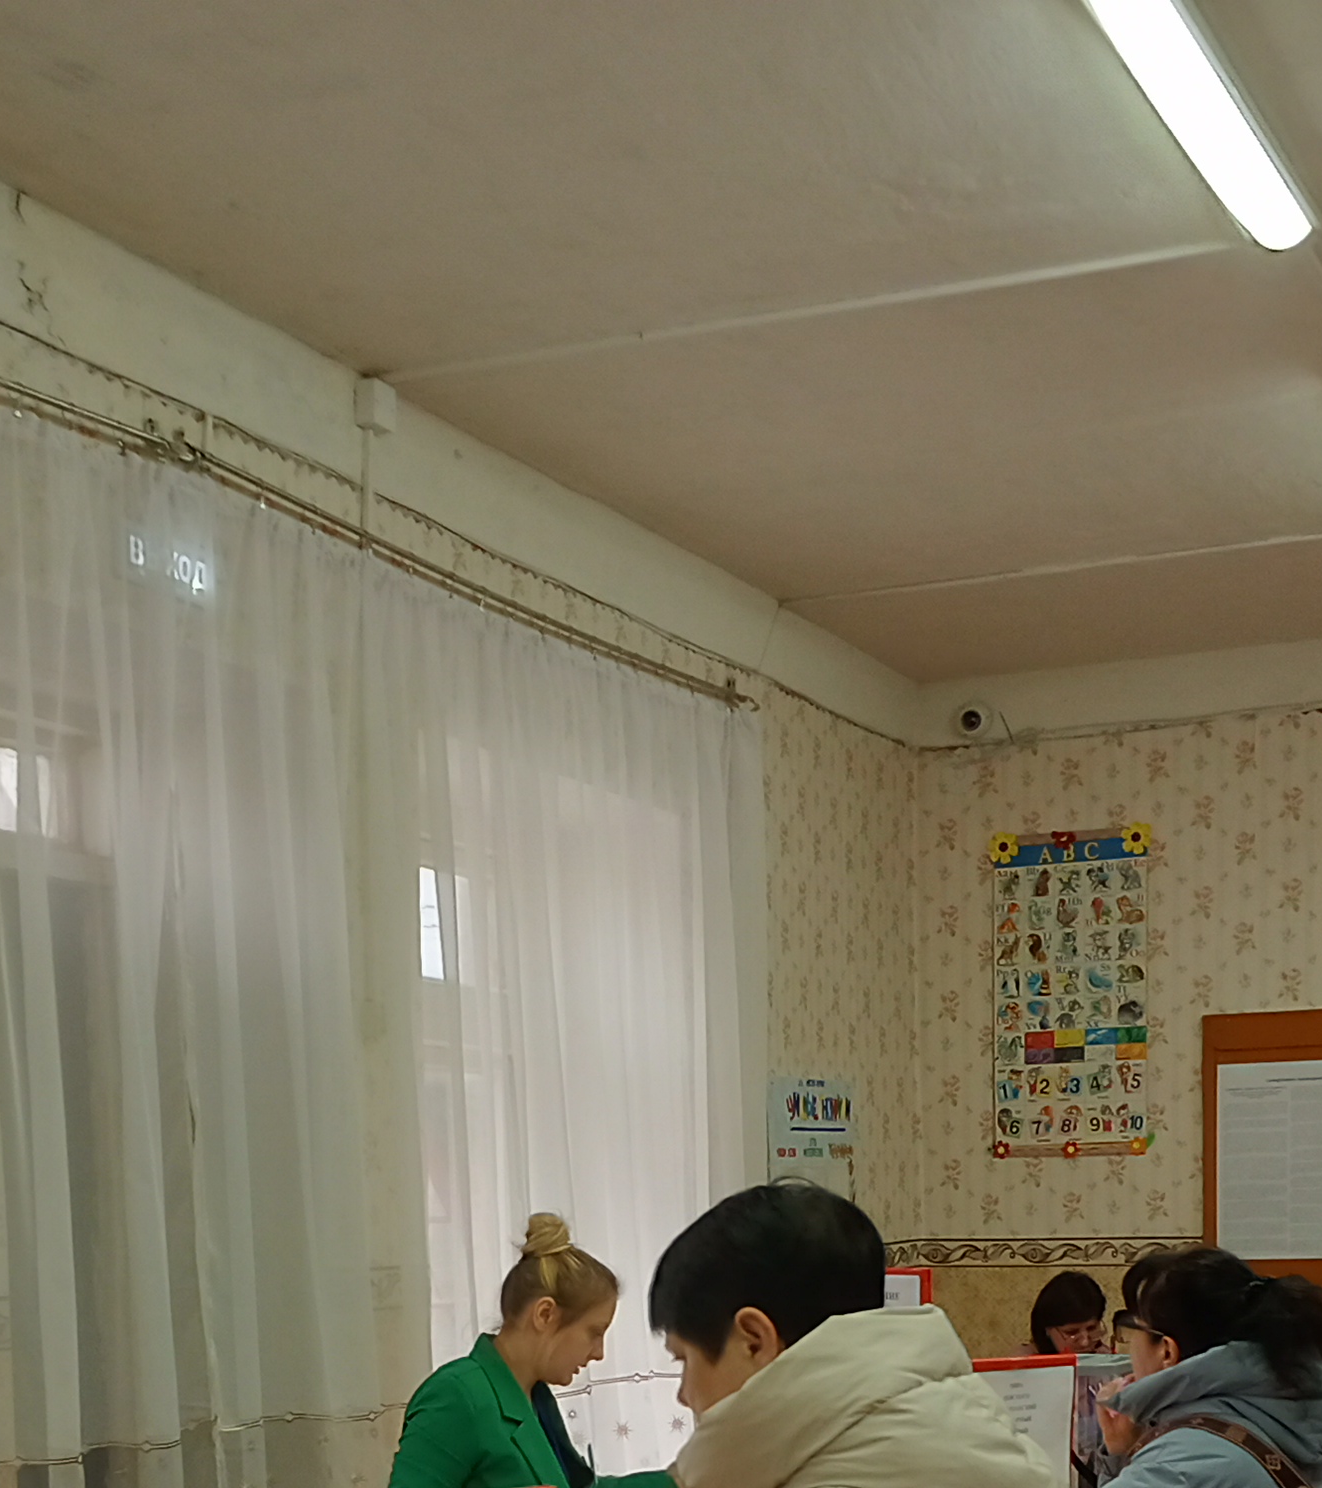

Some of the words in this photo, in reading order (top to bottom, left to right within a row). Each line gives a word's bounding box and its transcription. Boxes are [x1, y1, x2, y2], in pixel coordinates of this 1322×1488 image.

[1038, 846, 1053, 864] A
[1084, 842, 1100, 860] C
[999, 1083, 1008, 1099] 1
[1039, 1078, 1050, 1095] 2
[1070, 1077, 1080, 1094] 3
[1090, 1076, 1101, 1091] 4
[1130, 1073, 1142, 1089] 5
[1009, 1120, 1020, 1135] 6
[1031, 1120, 1042, 1135] 7
[1061, 1118, 1071, 1133] 8
[1090, 1117, 1101, 1131] 9
[1129, 1115, 1144, 1131] 10
